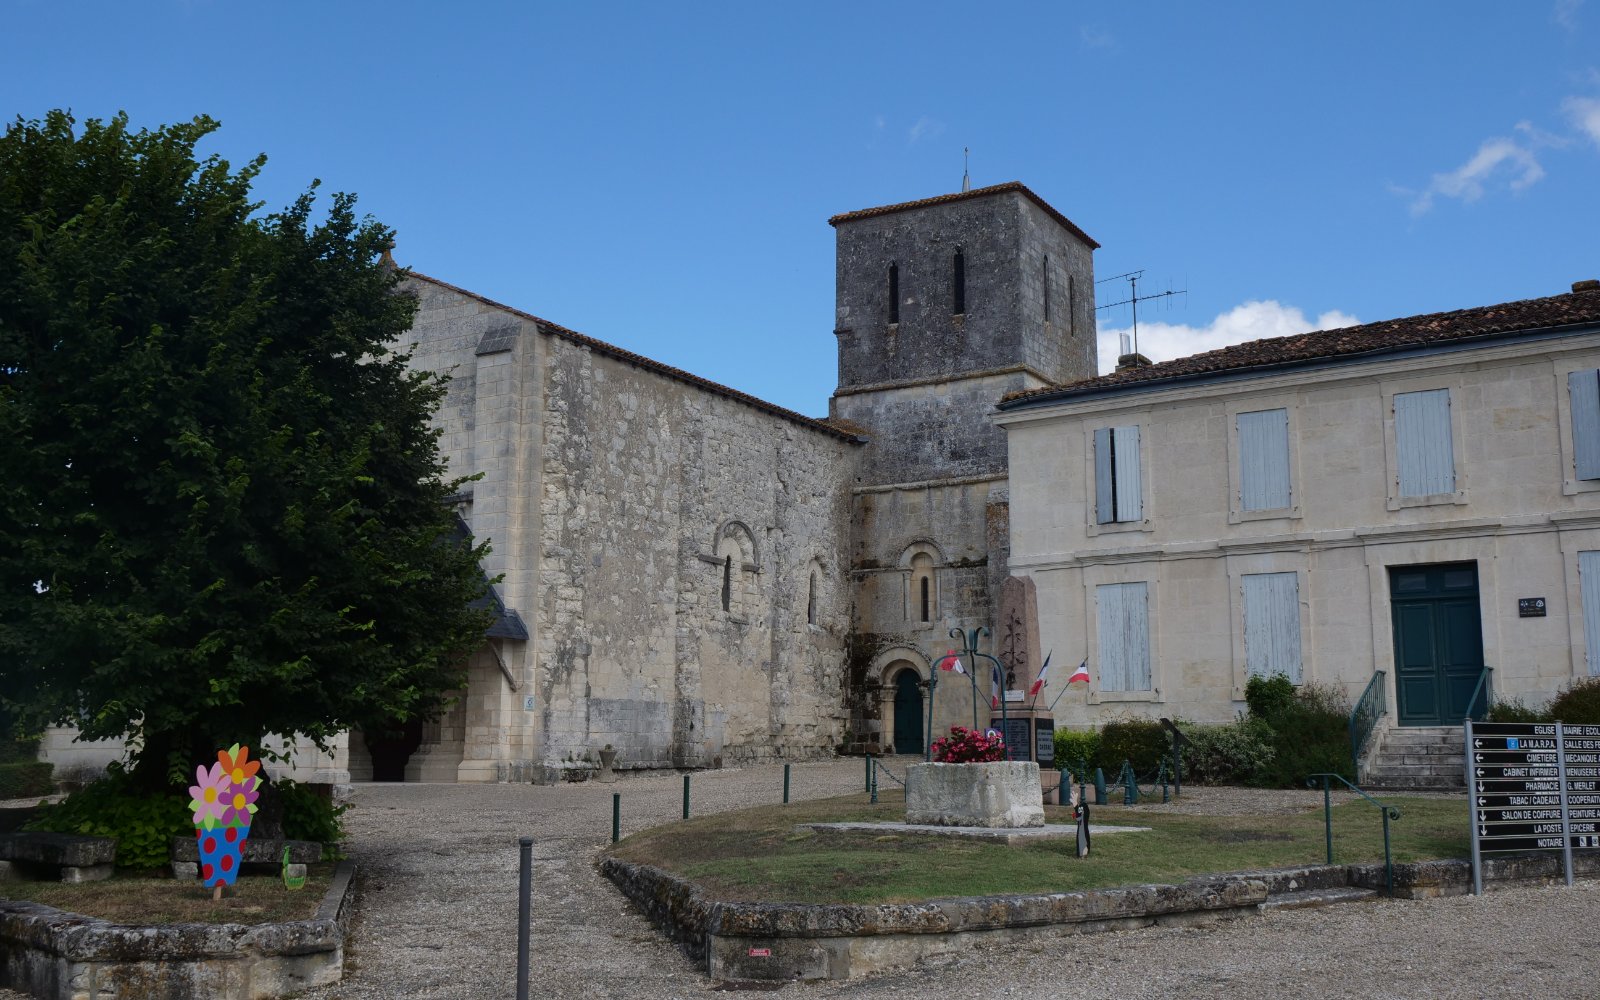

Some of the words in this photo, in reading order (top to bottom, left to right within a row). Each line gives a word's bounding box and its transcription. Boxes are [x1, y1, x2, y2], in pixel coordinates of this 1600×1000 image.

[1534, 726, 1555, 735] EGLISE
[1563, 726, 1582, 735] MAIRIE
[1520, 739, 1528, 748] LA
[1564, 740, 1582, 749] SALLE
[1583, 740, 1594, 749] DES
[1527, 753, 1557, 763] CIMETIERE
[1565, 754, 1597, 763] MECANIQUE
[1503, 768, 1528, 777] CABINET
[1530, 767, 1559, 777] INFIRMIER
[1566, 768, 1597, 777] MENUISERIE
[1525, 781, 1559, 791] PHARMACIE
[1574, 782, 1595, 790] MERLET
[1509, 796, 1528, 805] TABAC
[1532, 796, 1560, 805] CADEAUX
[1501, 810, 1522, 820] SALON
[1523, 810, 1531, 819] DE
[1532, 810, 1561, 819] COIFFURE
[1569, 810, 1596, 818] PEINTURE
[1534, 825, 1542, 833] LA
[1542, 824, 1562, 832] POSTE
[1570, 823, 1595, 832] EPICERIE
[1537, 838, 1563, 847] NOTAIRE
